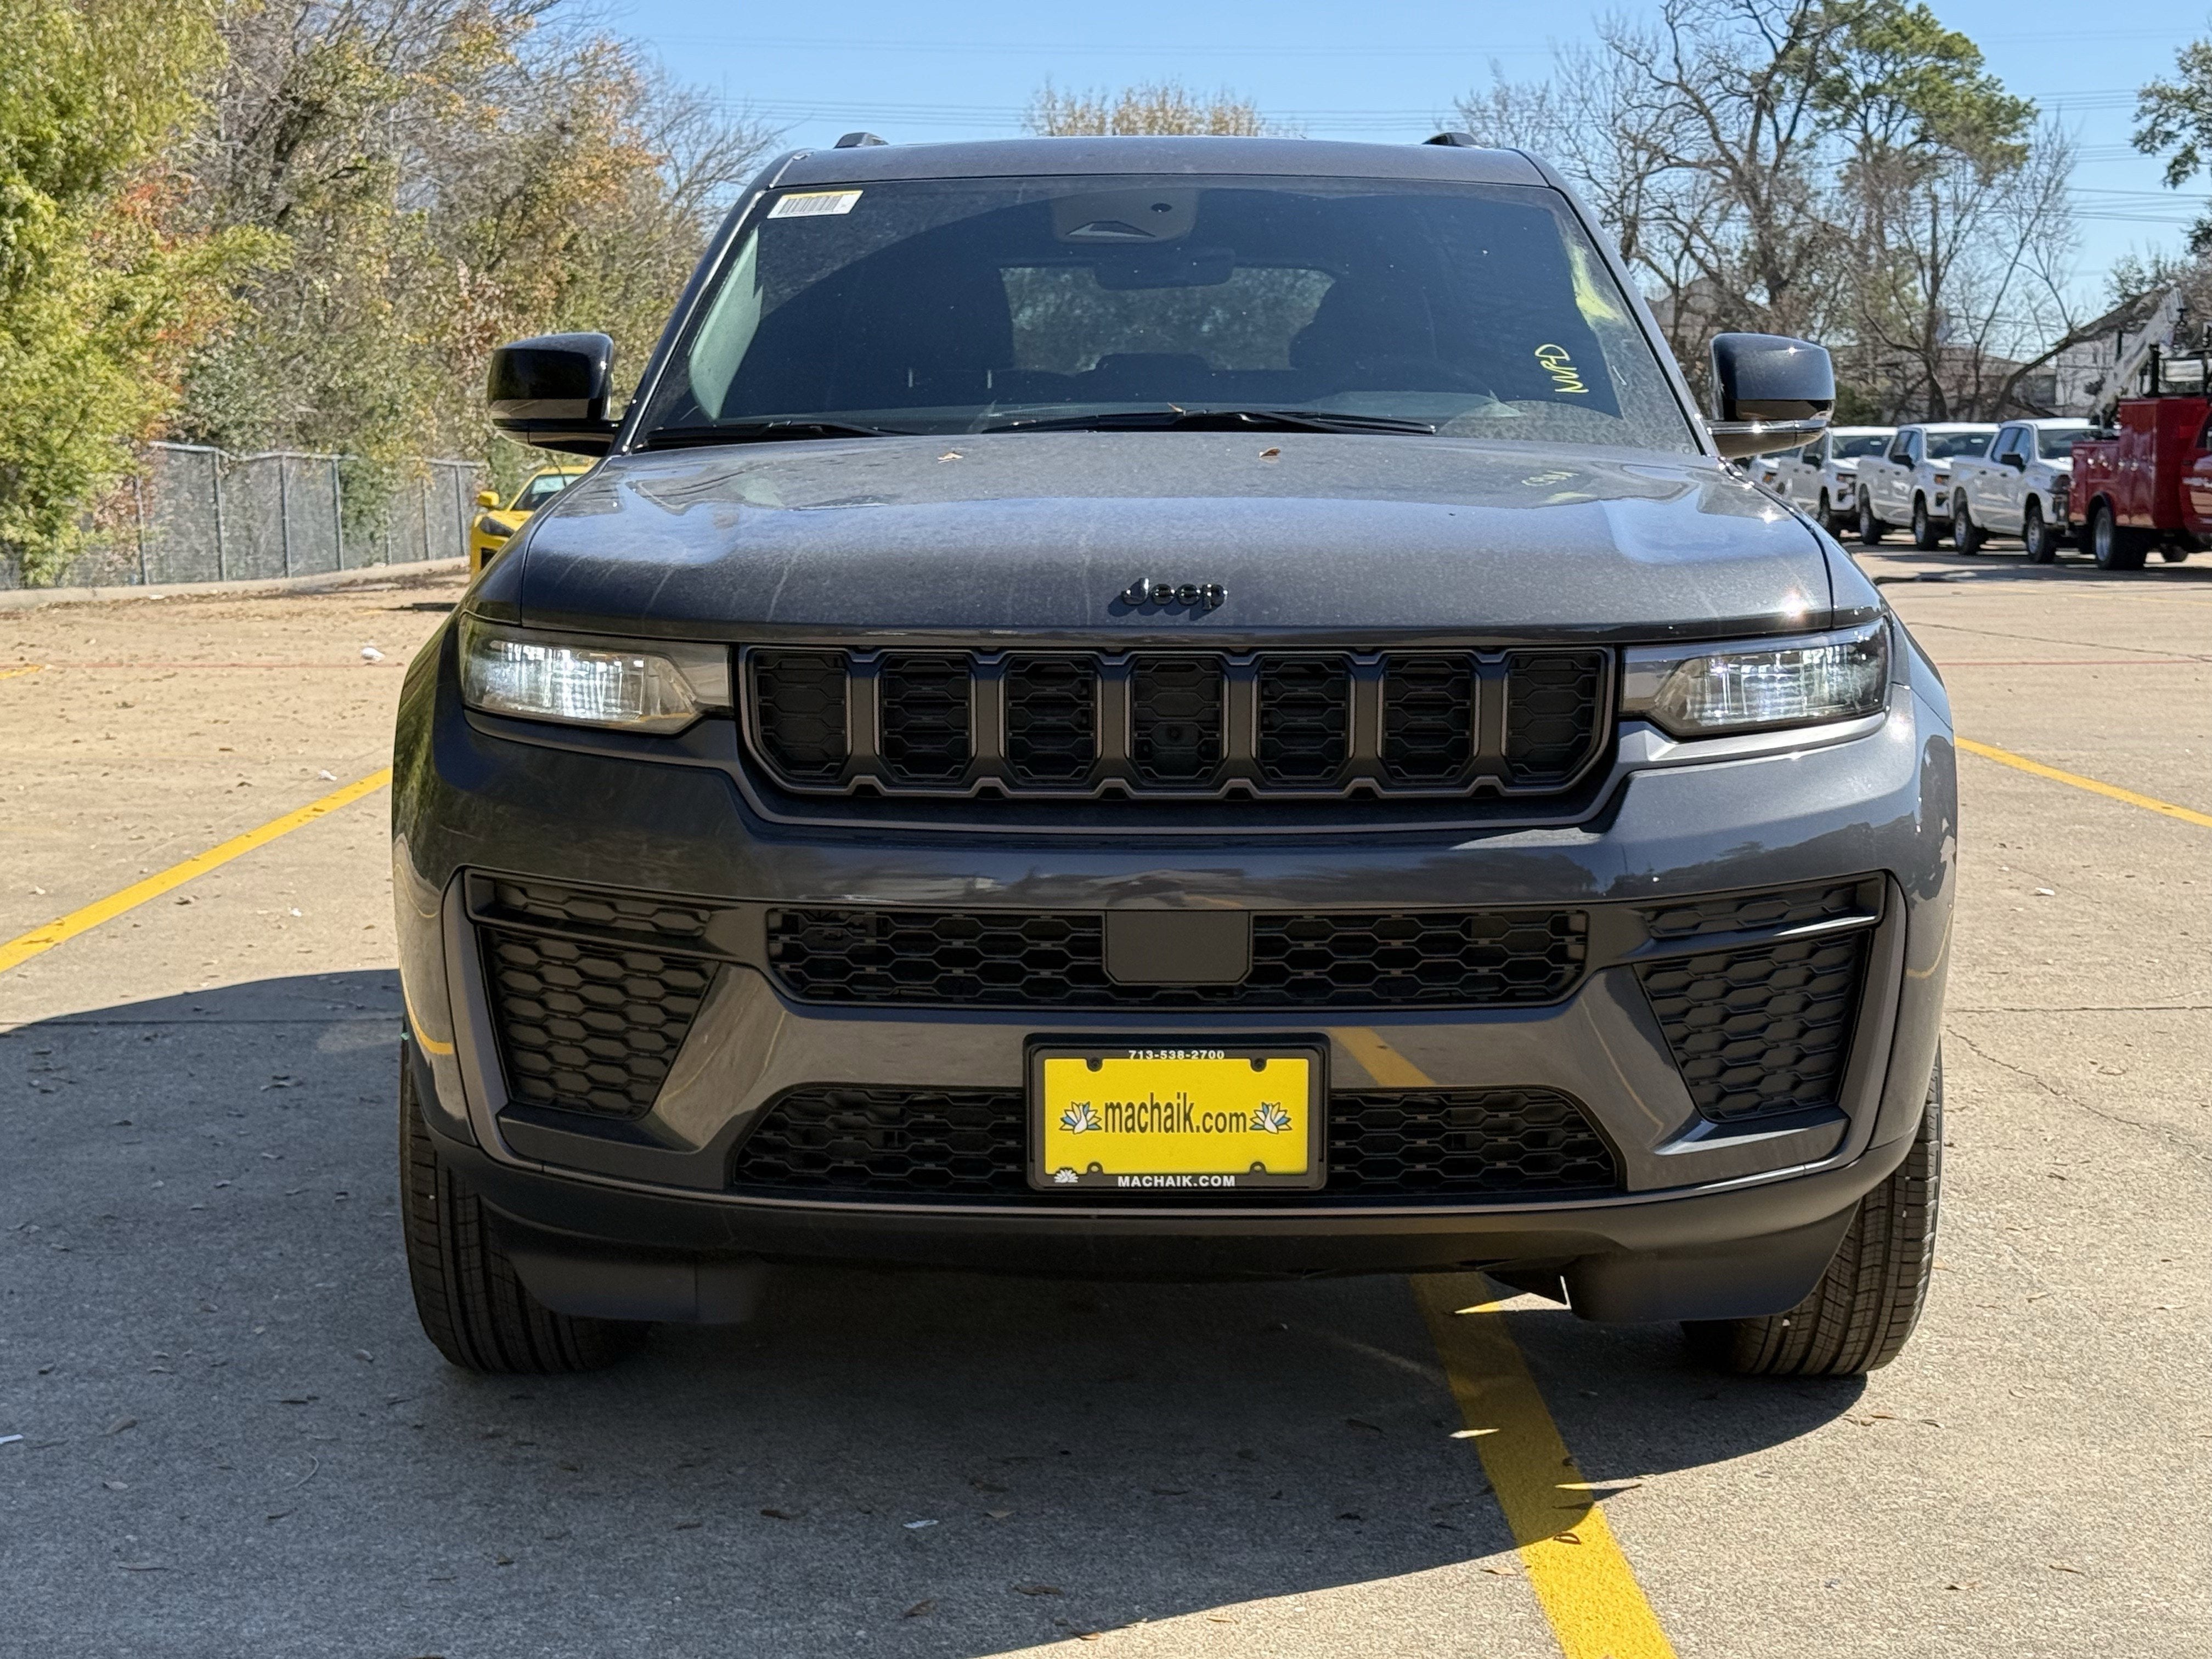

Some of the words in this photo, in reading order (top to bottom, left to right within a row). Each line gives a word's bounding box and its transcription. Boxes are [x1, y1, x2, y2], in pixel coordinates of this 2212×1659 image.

[1121, 577, 1228, 611] Jeep
[1128, 1049, 1225, 1060] 713-538-2700
[1104, 1091, 1247, 1133] machaik.com
[1117, 1175, 1235, 1187] MACHAIK.COM
